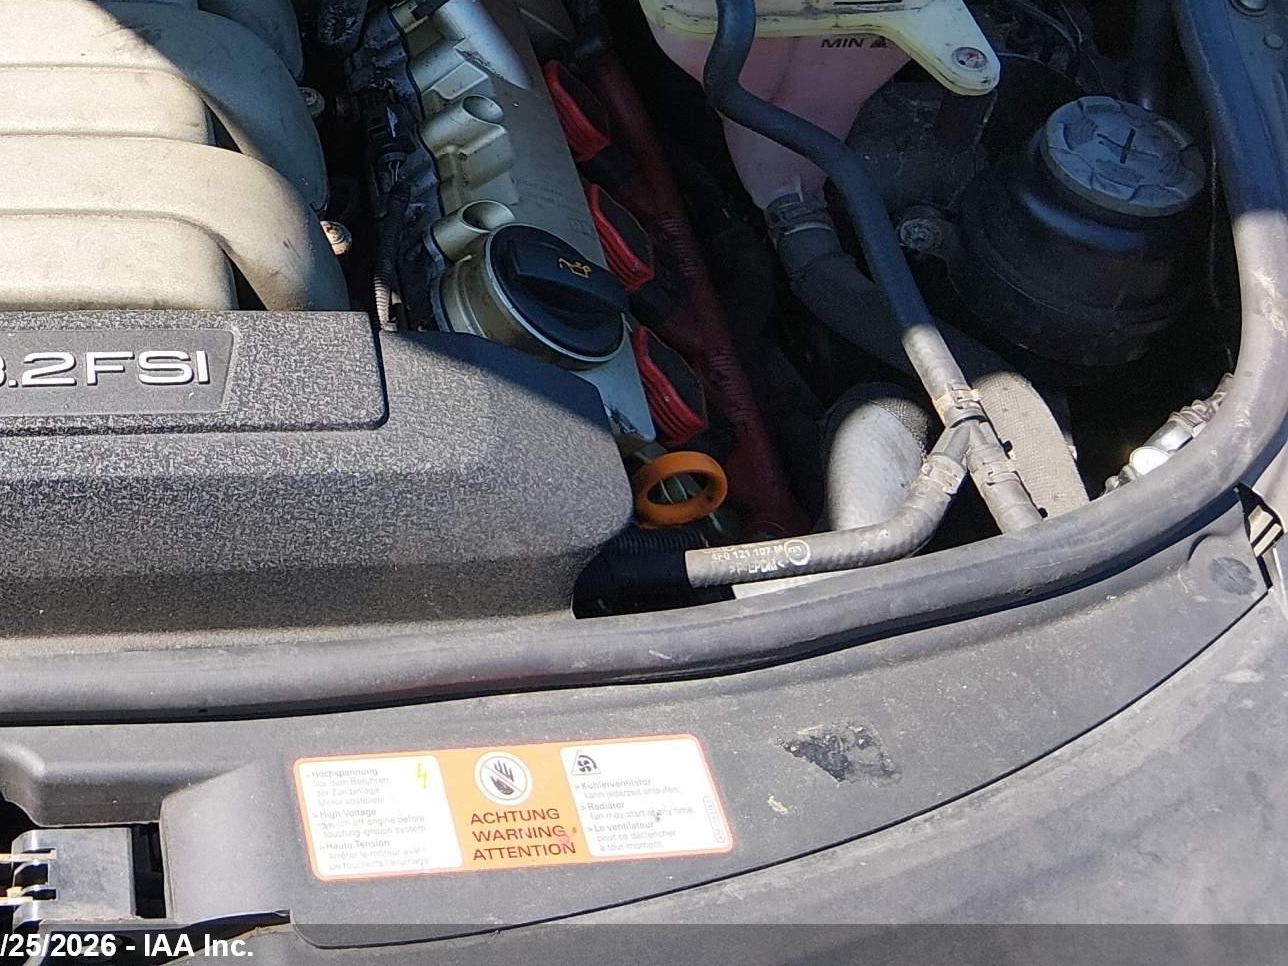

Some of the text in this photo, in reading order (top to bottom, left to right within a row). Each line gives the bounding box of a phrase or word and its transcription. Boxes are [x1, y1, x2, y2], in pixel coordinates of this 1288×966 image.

[821, 38, 864, 48] MIN
[588, 802, 624, 810] Radiator
[320, 809, 377, 820] High Voltage
[470, 808, 560, 825] ACHTUNG
[367, 818, 395, 826] engine
[397, 815, 424, 823] before
[593, 821, 655, 832] Le ventilateur
[472, 826, 565, 843] WARNING
[355, 839, 390, 848] Tension
[473, 843, 576, 861] ATTENTION
